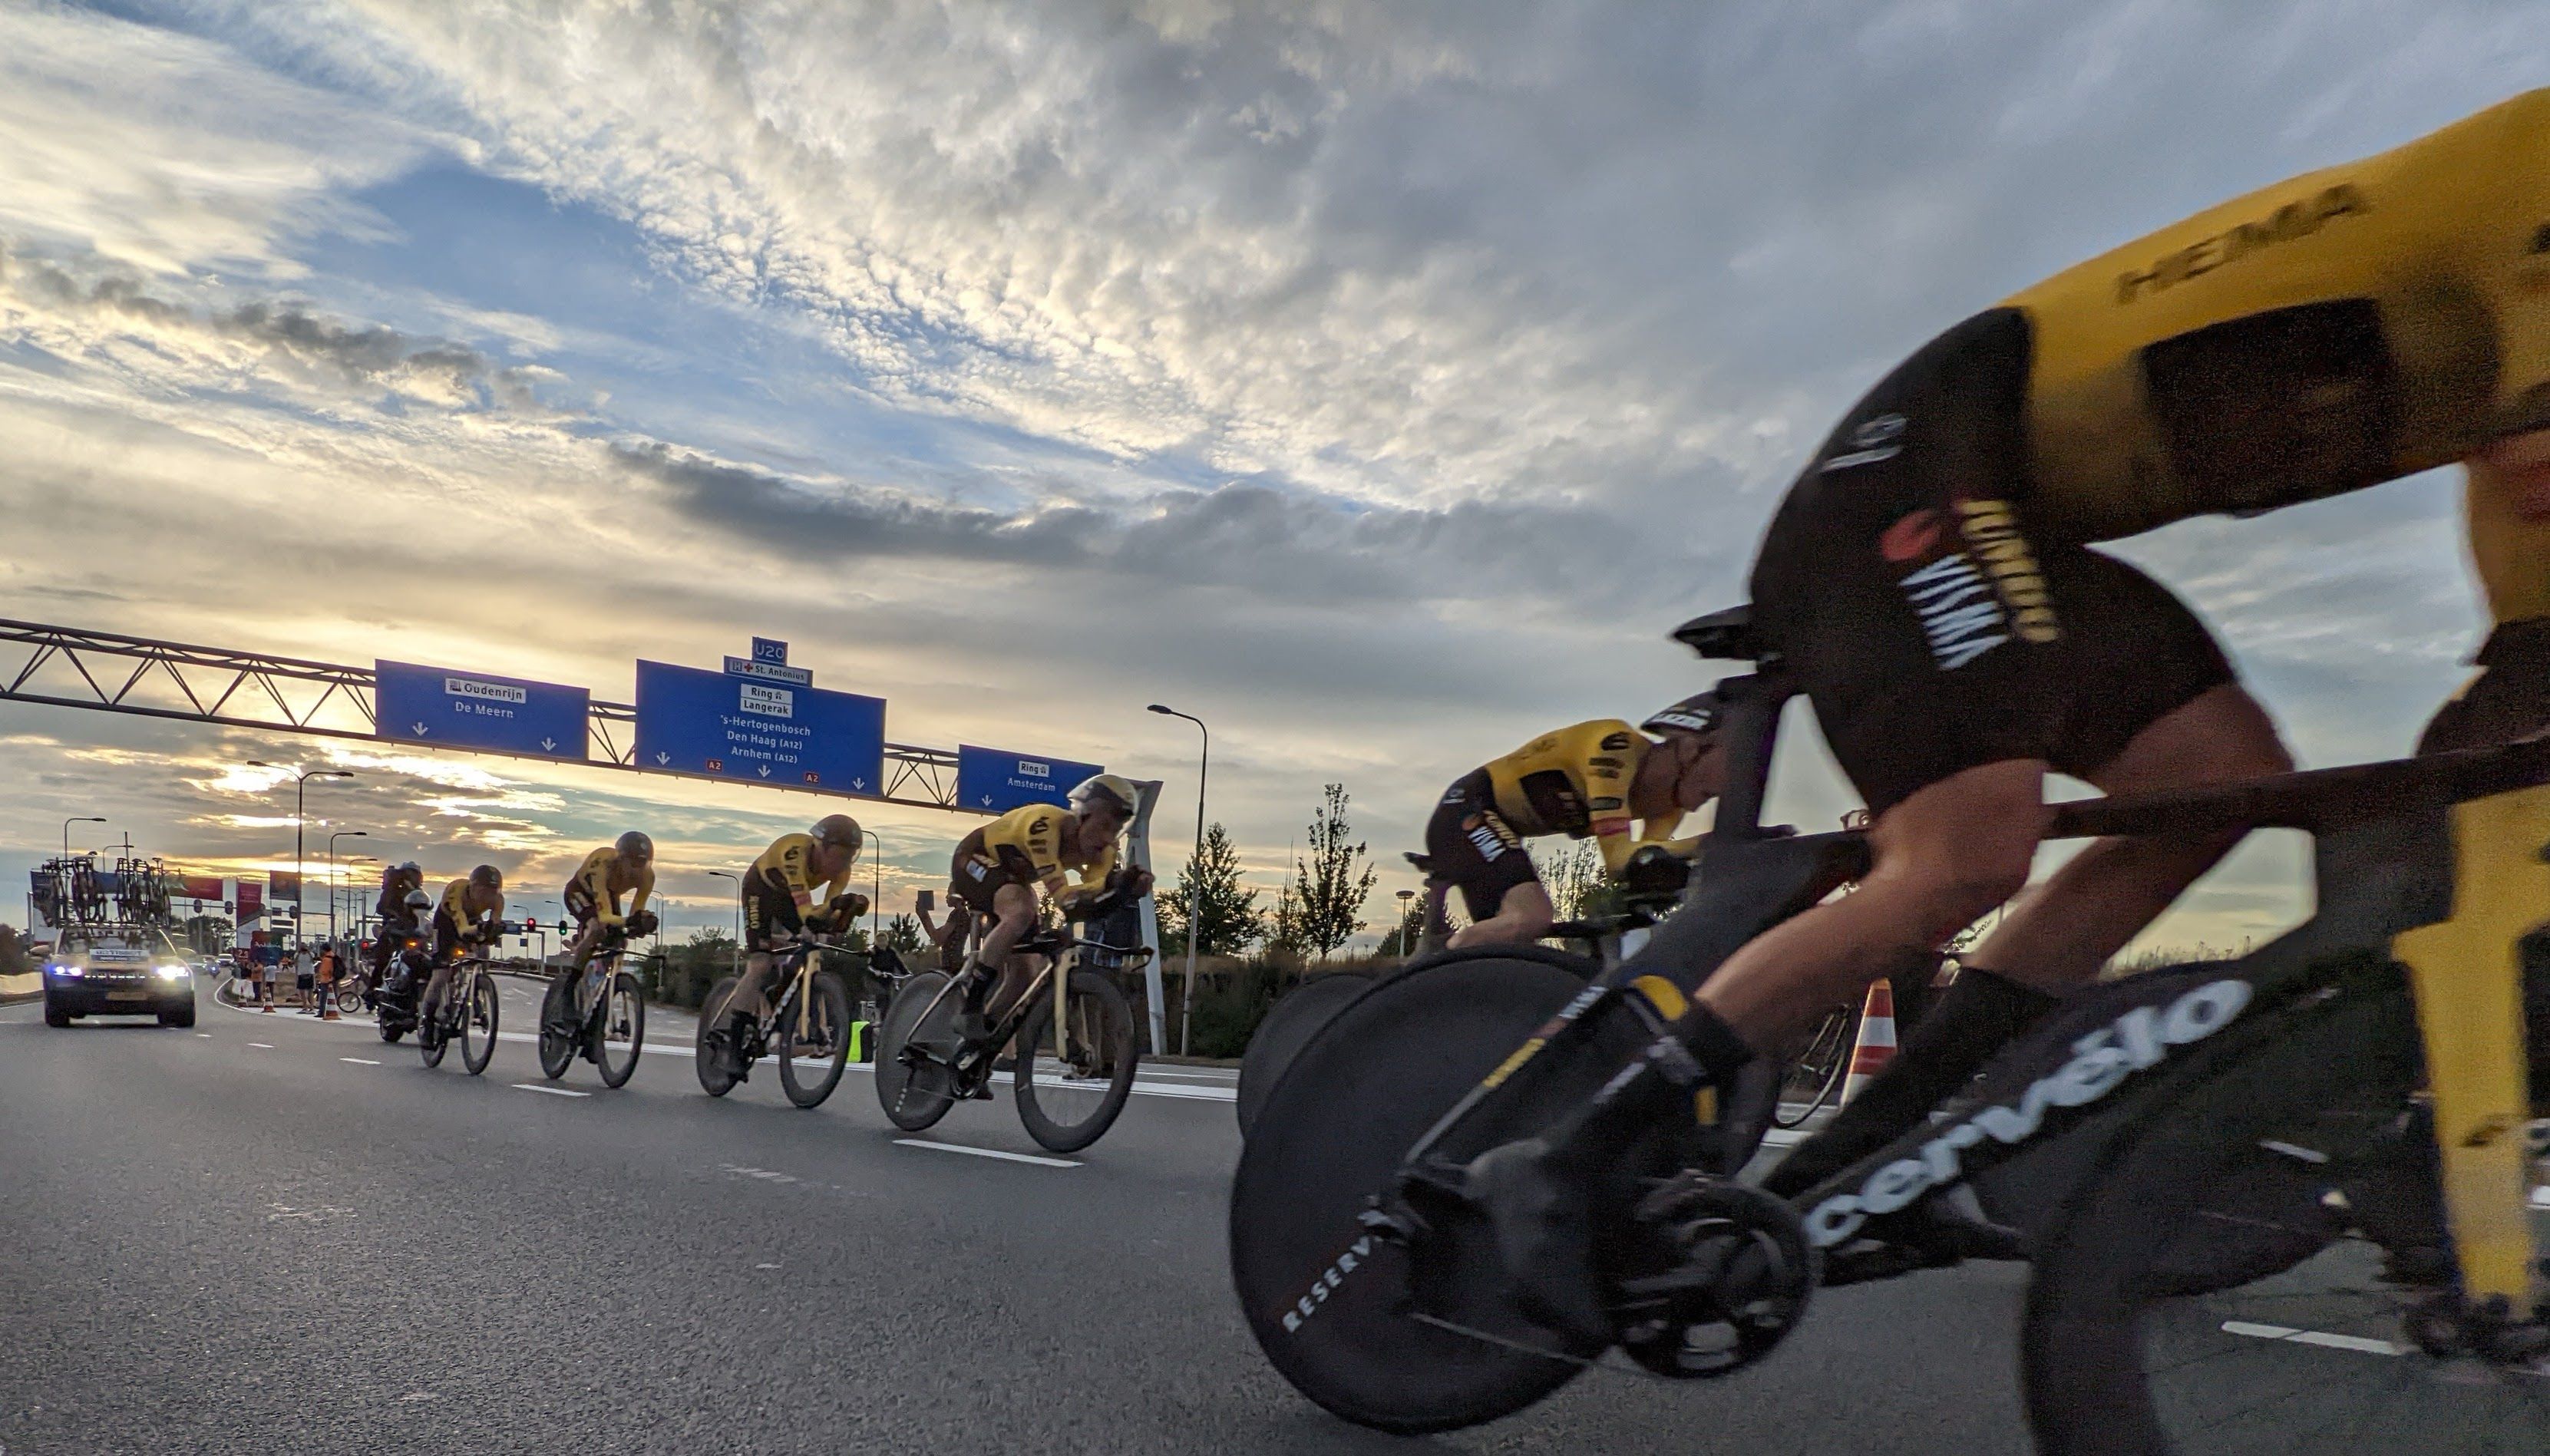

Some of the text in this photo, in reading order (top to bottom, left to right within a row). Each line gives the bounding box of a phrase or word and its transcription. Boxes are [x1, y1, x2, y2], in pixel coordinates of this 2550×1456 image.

[754, 642, 784, 659] U20
[755, 665, 765, 675] St.
[768, 668, 804, 681] Antonius
[464, 682, 523, 701] Oudenrijn
[751, 687, 772, 701] Ring
[455, 702, 514, 718] De Meern
[744, 699, 788, 715] Langerak
[720, 715, 811, 737] 's-Hertogenbosch
[728, 731, 802, 751] Den Haag (A12)
[731, 746, 798, 764] Arnhem (A12)
[709, 761, 721, 771] A2
[1021, 762, 1039, 774] Ring
[806, 773, 818, 783] A2
[1007, 778, 1055, 791] Amsterdam
[1282, 1236, 1382, 1334] RESERV
